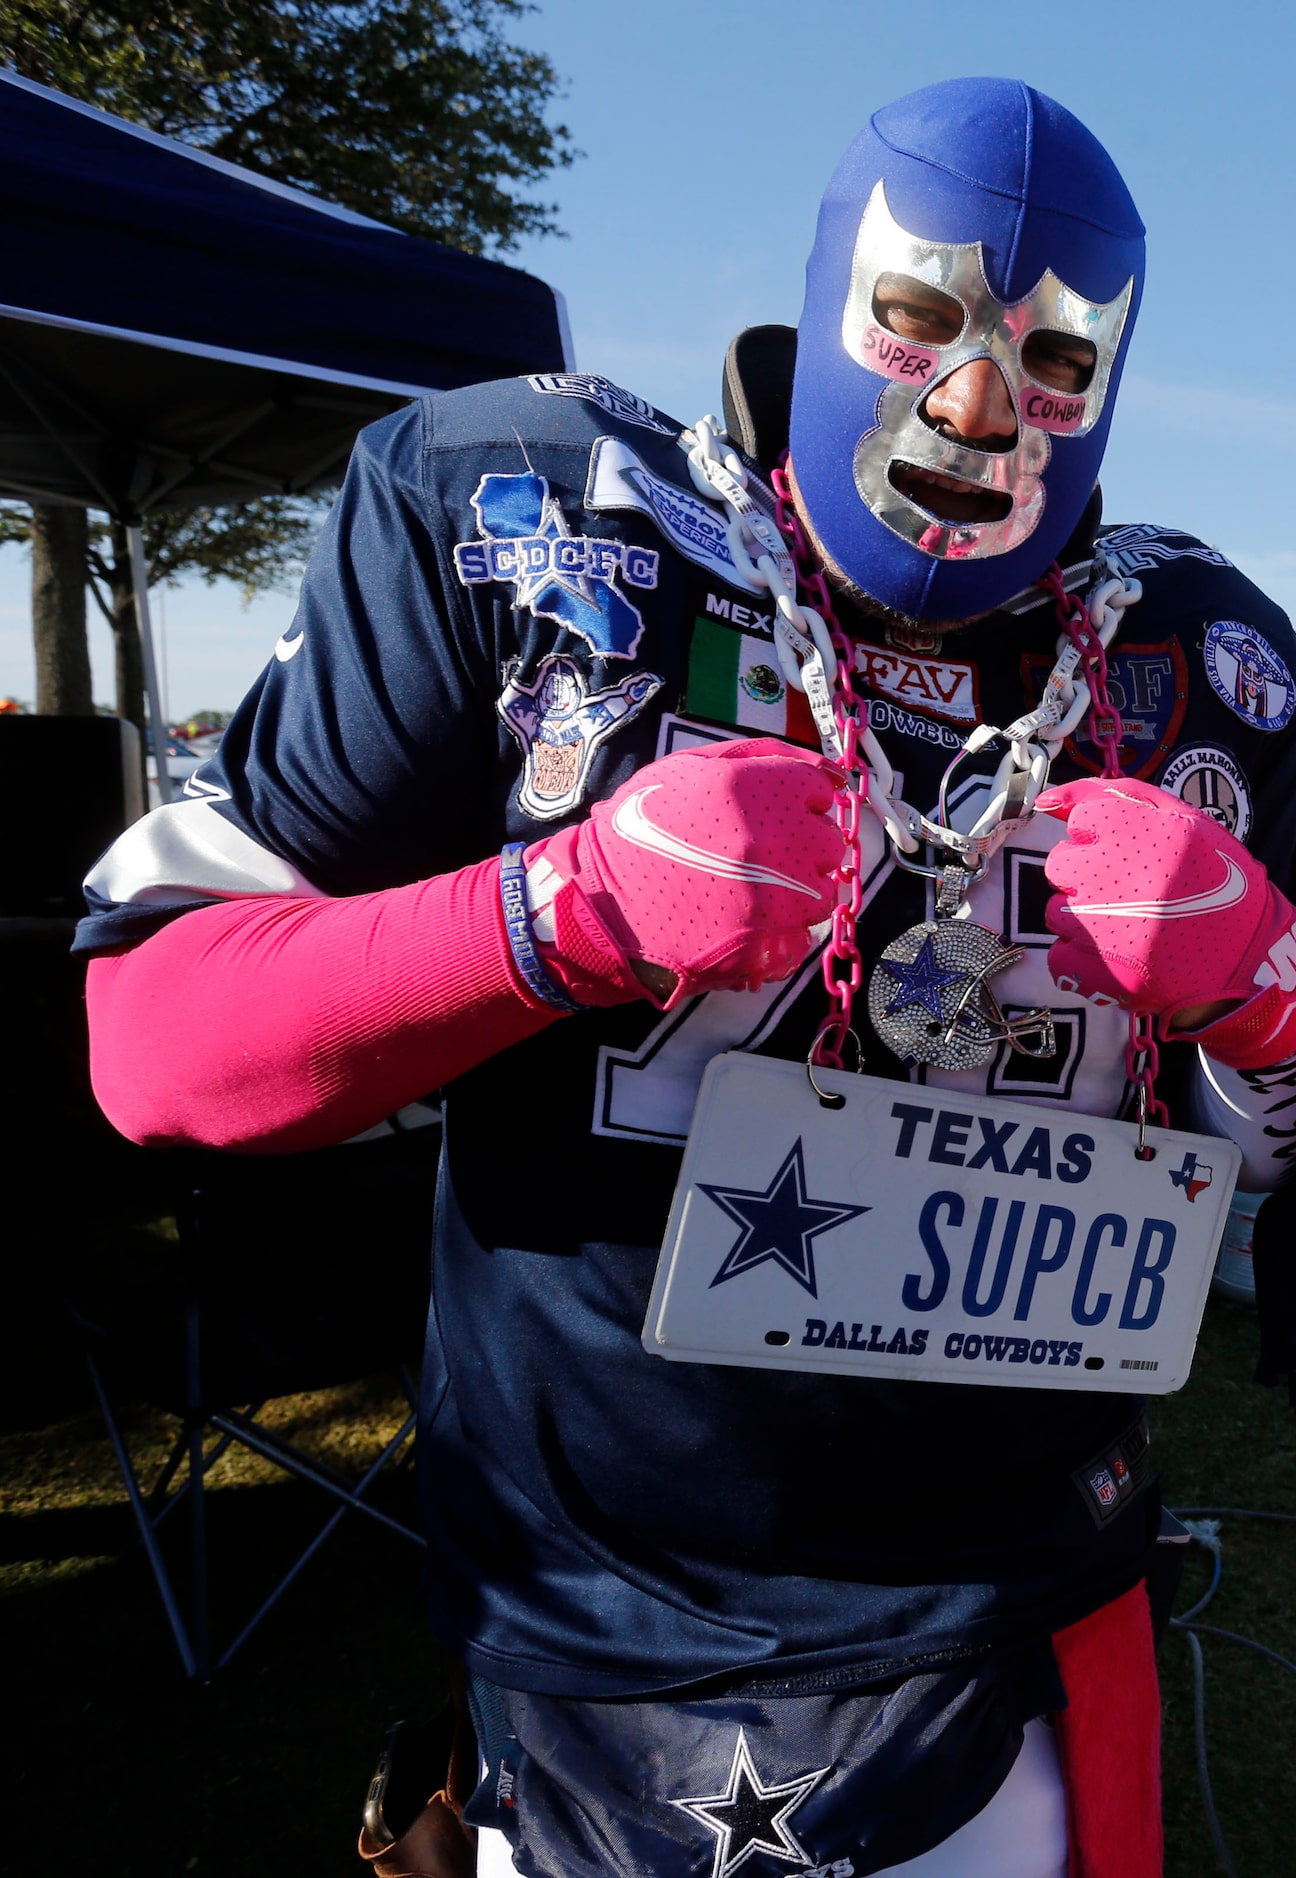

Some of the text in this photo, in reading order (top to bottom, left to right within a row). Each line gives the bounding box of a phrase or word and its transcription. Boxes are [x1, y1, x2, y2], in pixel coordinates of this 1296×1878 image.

[863, 328, 932, 379] SUPER
[1026, 395, 1086, 422] COWBOY
[455, 537, 659, 589] SCDCFC
[1163, 754, 1197, 789] BALLZ
[576, 905, 611, 949] VAPOR
[890, 1101, 1095, 1184] TEXAS
[901, 1190, 1177, 1331] SUPCB
[802, 1318, 1083, 1367] DALLAS COWBOYS
